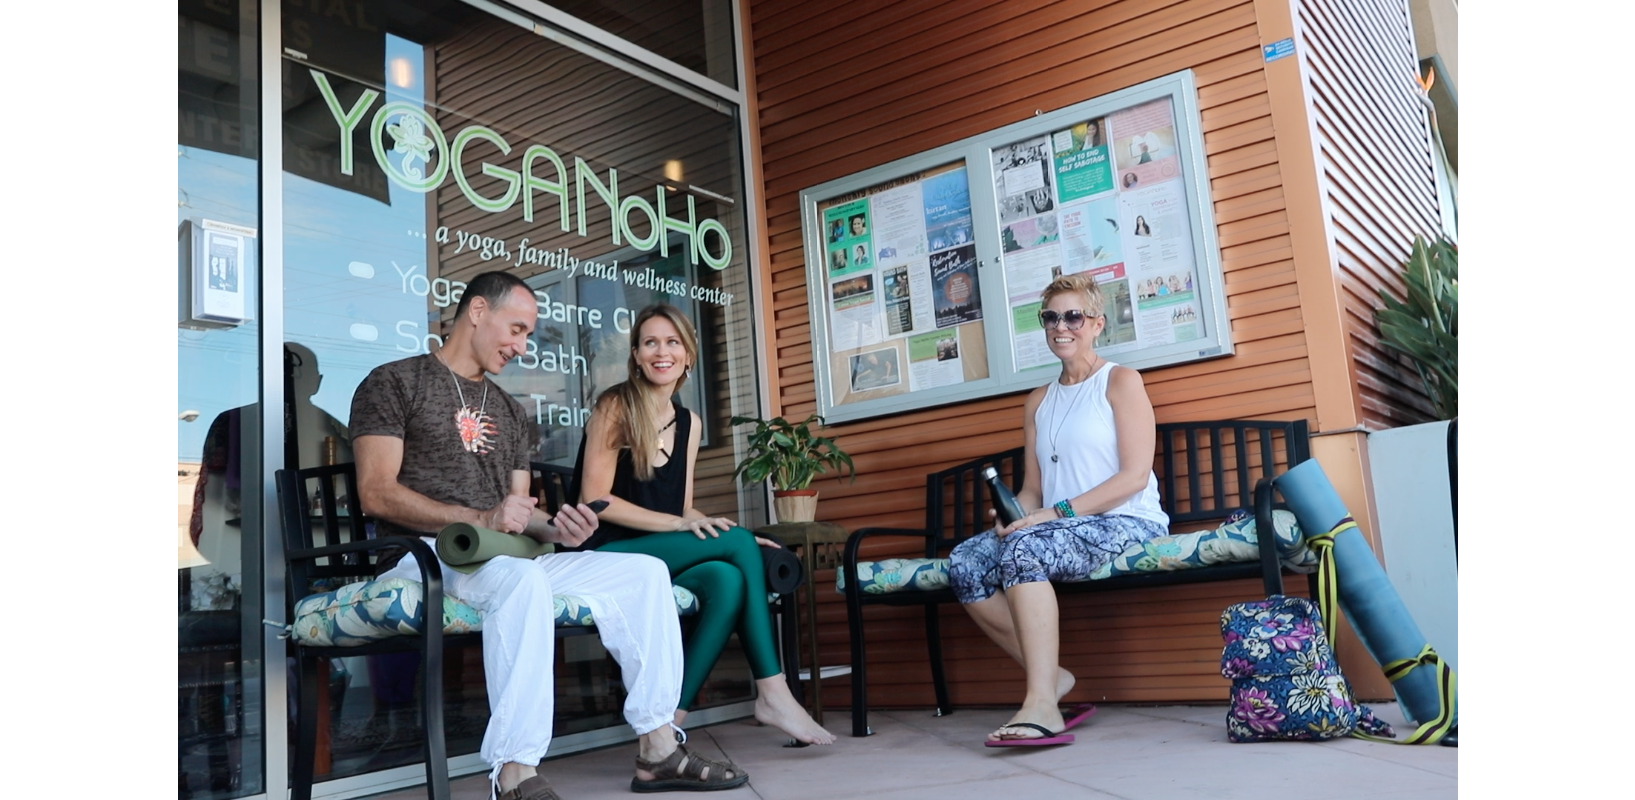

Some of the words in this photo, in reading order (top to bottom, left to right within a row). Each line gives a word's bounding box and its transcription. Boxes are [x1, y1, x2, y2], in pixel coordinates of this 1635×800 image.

[309, 69, 732, 270] YOGANoHo
[1058, 164, 1073, 173] SELF
[1074, 155, 1105, 169] SABOTAGE
[1062, 154, 1077, 164] HOW
[1077, 153, 1085, 161] TO
[1086, 149, 1099, 158] END
[435, 226, 449, 245] a
[455, 227, 512, 268] yoga,
[516, 238, 579, 280] family
[583, 256, 618, 283] and
[622, 265, 687, 297] wellness
[690, 284, 734, 307] center
[390, 260, 468, 308] Yoga
[533, 291, 602, 329] Barre
[518, 338, 588, 377] Bath
[530, 393, 592, 428] Train
